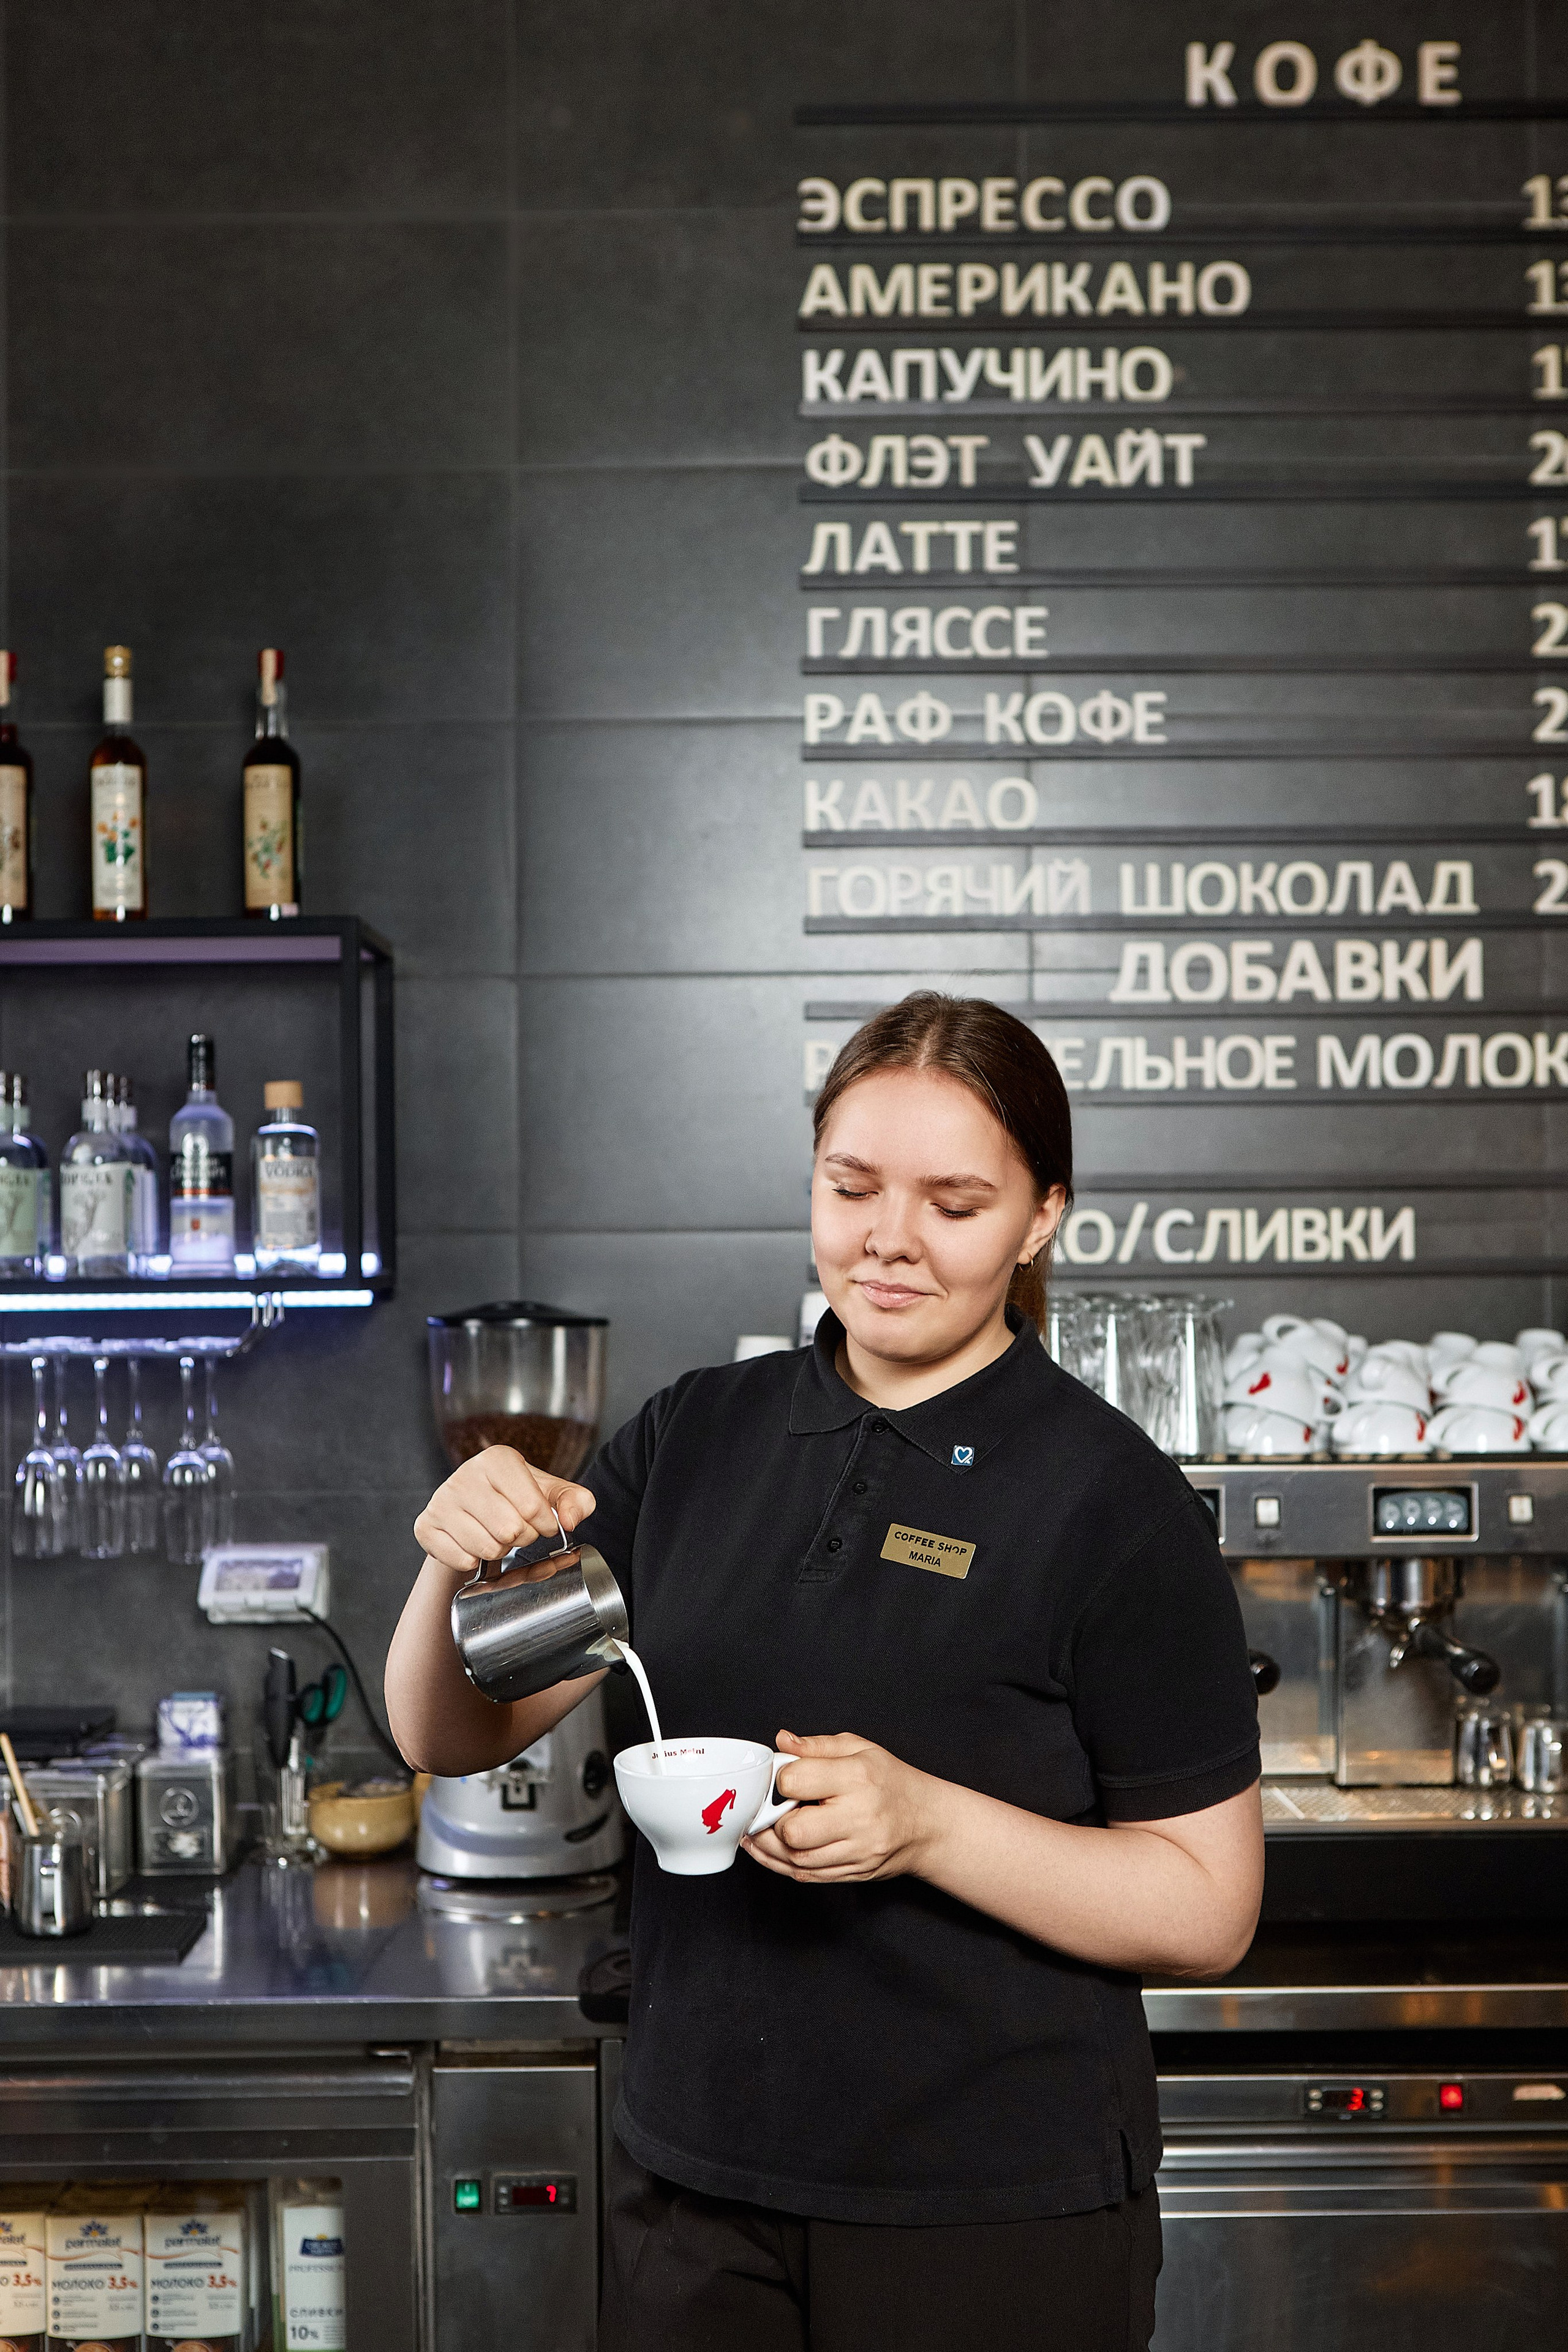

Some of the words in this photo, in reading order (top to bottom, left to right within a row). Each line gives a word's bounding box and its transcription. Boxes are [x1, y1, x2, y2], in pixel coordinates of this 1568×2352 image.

[1185, 39, 1461, 107] КОФЕ
[797, 175, 1171, 232] ЭСПРЕССО
[799, 261, 1252, 317] АМЕРИКАНО
[802, 347, 1173, 402] КАПУЧИНО
[1532, 344, 1568, 399] 1
[804, 432, 990, 488] ФЛЭТ
[1024, 428, 1207, 488] УАЙТ
[1529, 430, 1568, 486] 2
[802, 521, 1019, 574] ЛАТТЕ
[1528, 516, 1568, 571] 1
[806, 606, 1050, 658] ГЛЯССЕ
[804, 690, 952, 745] РАФ
[985, 690, 1168, 745] КОФЕ
[803, 777, 1039, 831] КАКАО
[1527, 772, 1568, 829] 1
[807, 858, 1091, 917] ГОРЯЧИЙ
[1120, 861, 1479, 917] ШОКОЛАД
[1109, 937, 1483, 1003] ДОБАВКИ
[1054, 1202, 1416, 1264] О/СЛИВКИ
[894, 1531, 935, 1548] COFFEE
[937, 1542, 967, 1556] SHOP
[908, 1551, 941, 1567] MARIA
